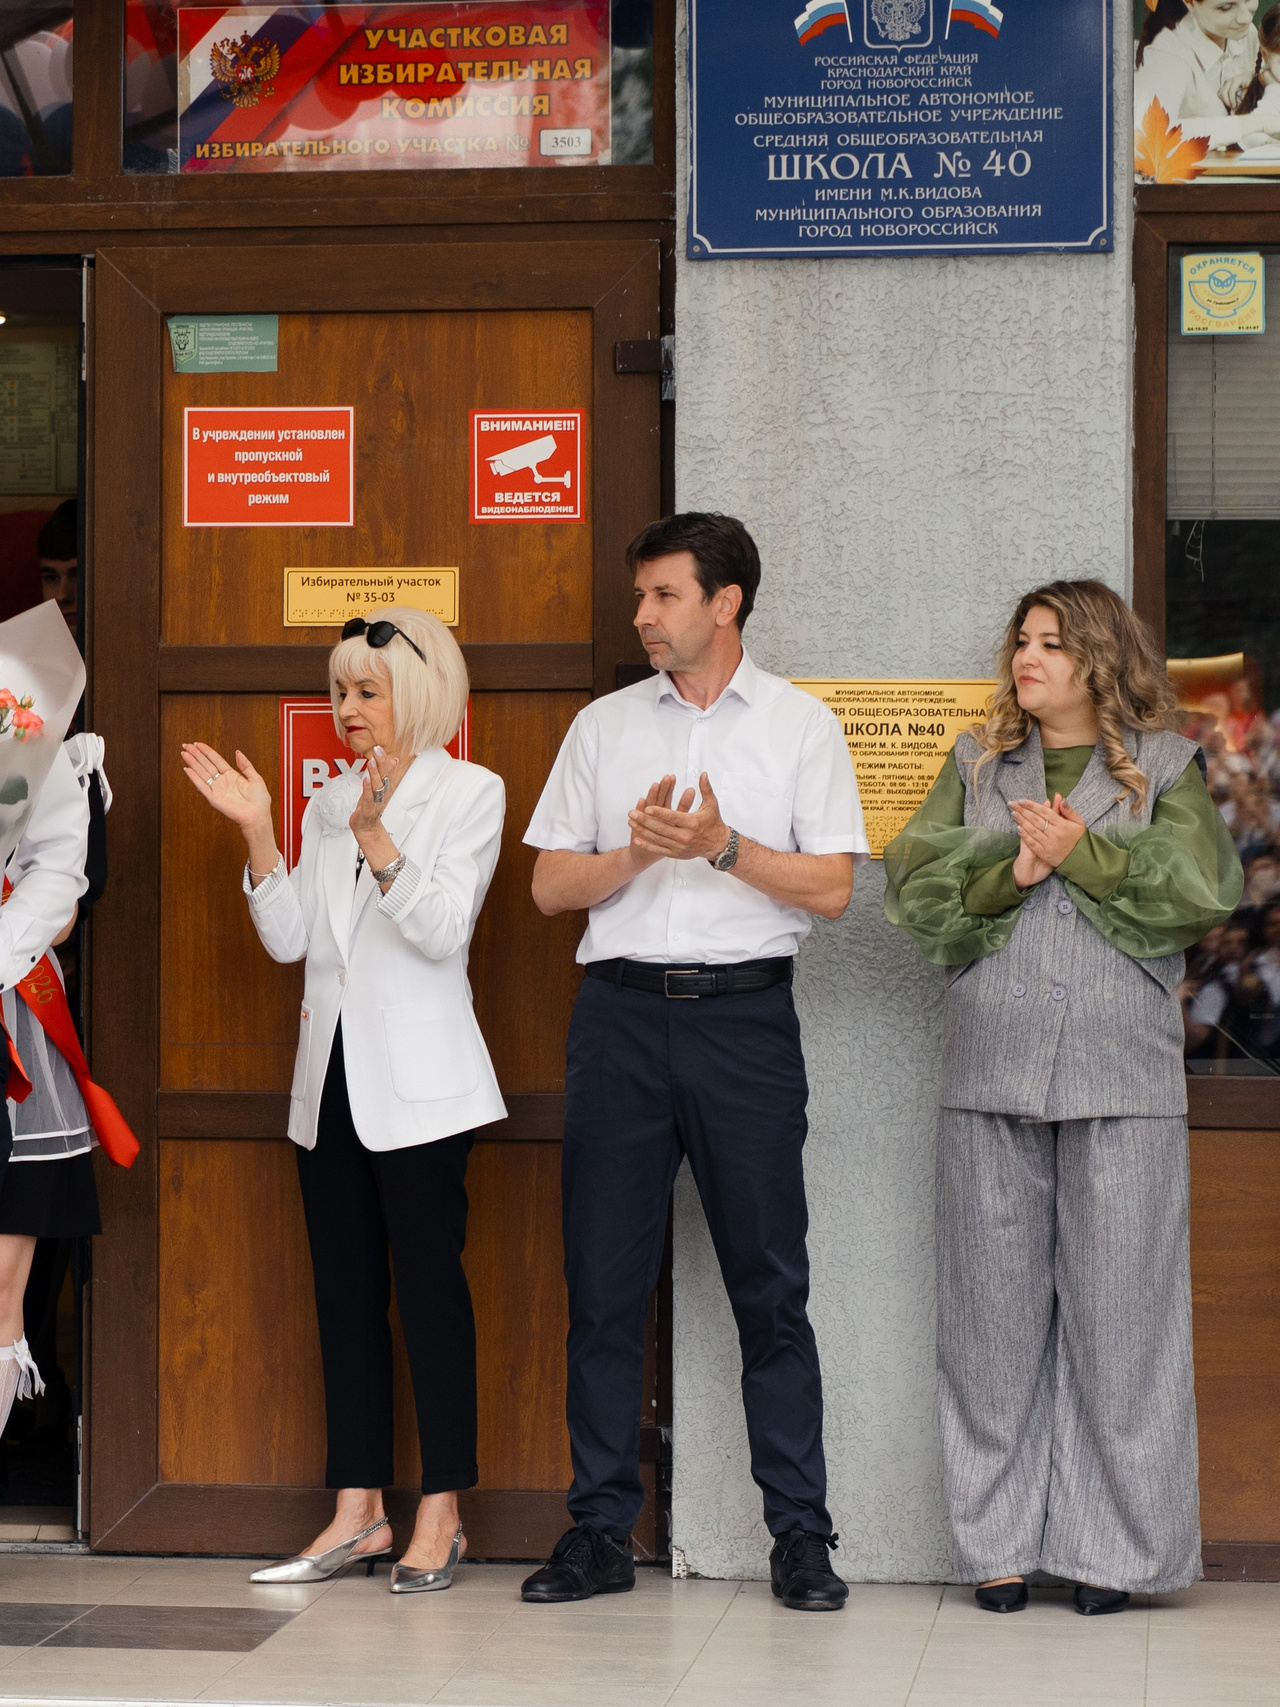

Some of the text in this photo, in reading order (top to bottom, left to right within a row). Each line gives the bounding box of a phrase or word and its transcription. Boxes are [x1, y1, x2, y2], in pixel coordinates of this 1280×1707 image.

[365, 24, 568, 50] УЧАСТКОВАЯ
[814, 53, 979, 67] РОССИЙСКАЯ ФЕДЕРАЦИЯ
[338, 58, 593, 86] ИЗБИРАТЕЛЬНАЯ
[827, 64, 972, 78] КРАСНОДАРСКИЙ КРАЙ
[821, 76, 973, 91] ГОРОД НОВОРОССИЙСК
[381, 95, 551, 119] КОМИССИЯ
[764, 91, 1035, 109] МУНИЦИПАЛЬНОЕ АВТОНОМНОЕ
[735, 107, 1063, 126] ОБЩЕОБРАЗОВАТЕЛЬНОЕ УЧРЕЖДЕНИЕ
[195, 135, 582, 158] ИЗБИРАТЕЛЬНОГО УЧАСТКА № 3503
[753, 130, 1044, 149] СРЕДНЯЯ ОБЩЕОБРАЗОВАТЕЛЬНАЯ
[767, 149, 1032, 181] ШКОЛА № 40
[815, 186, 983, 201] ИМЕНИ М.К.ВИДОВА
[755, 205, 1042, 222] МУНИЦИПАЛЬНОГО ОБРАЗОВАНИЯ
[799, 221, 999, 239] ГОРОД НОВОРОССИЙСК
[1190, 257, 1255, 275] ОХРАНЯЕТСЯ
[1189, 308, 1257, 328] РОСГВАРДИЯ
[480, 420, 575, 431] ВНИМАНИЕ!!!
[192, 427, 345, 443] В учреждении установлен
[234, 448, 303, 464] пропускной
[207, 469, 330, 485] и внутреобъектовый
[248, 493, 290, 506] режим
[494, 492, 561, 504] ВЕДЕТСЯ
[481, 506, 574, 514] ВИДЕОНАБЛЮДЕНИЕ
[301, 576, 441, 589] Избирательный участок
[346, 592, 396, 603] № 35-03
[844, 722, 945, 736] ШКОЛА №40
[901, 742, 938, 750] ВИДОВА
